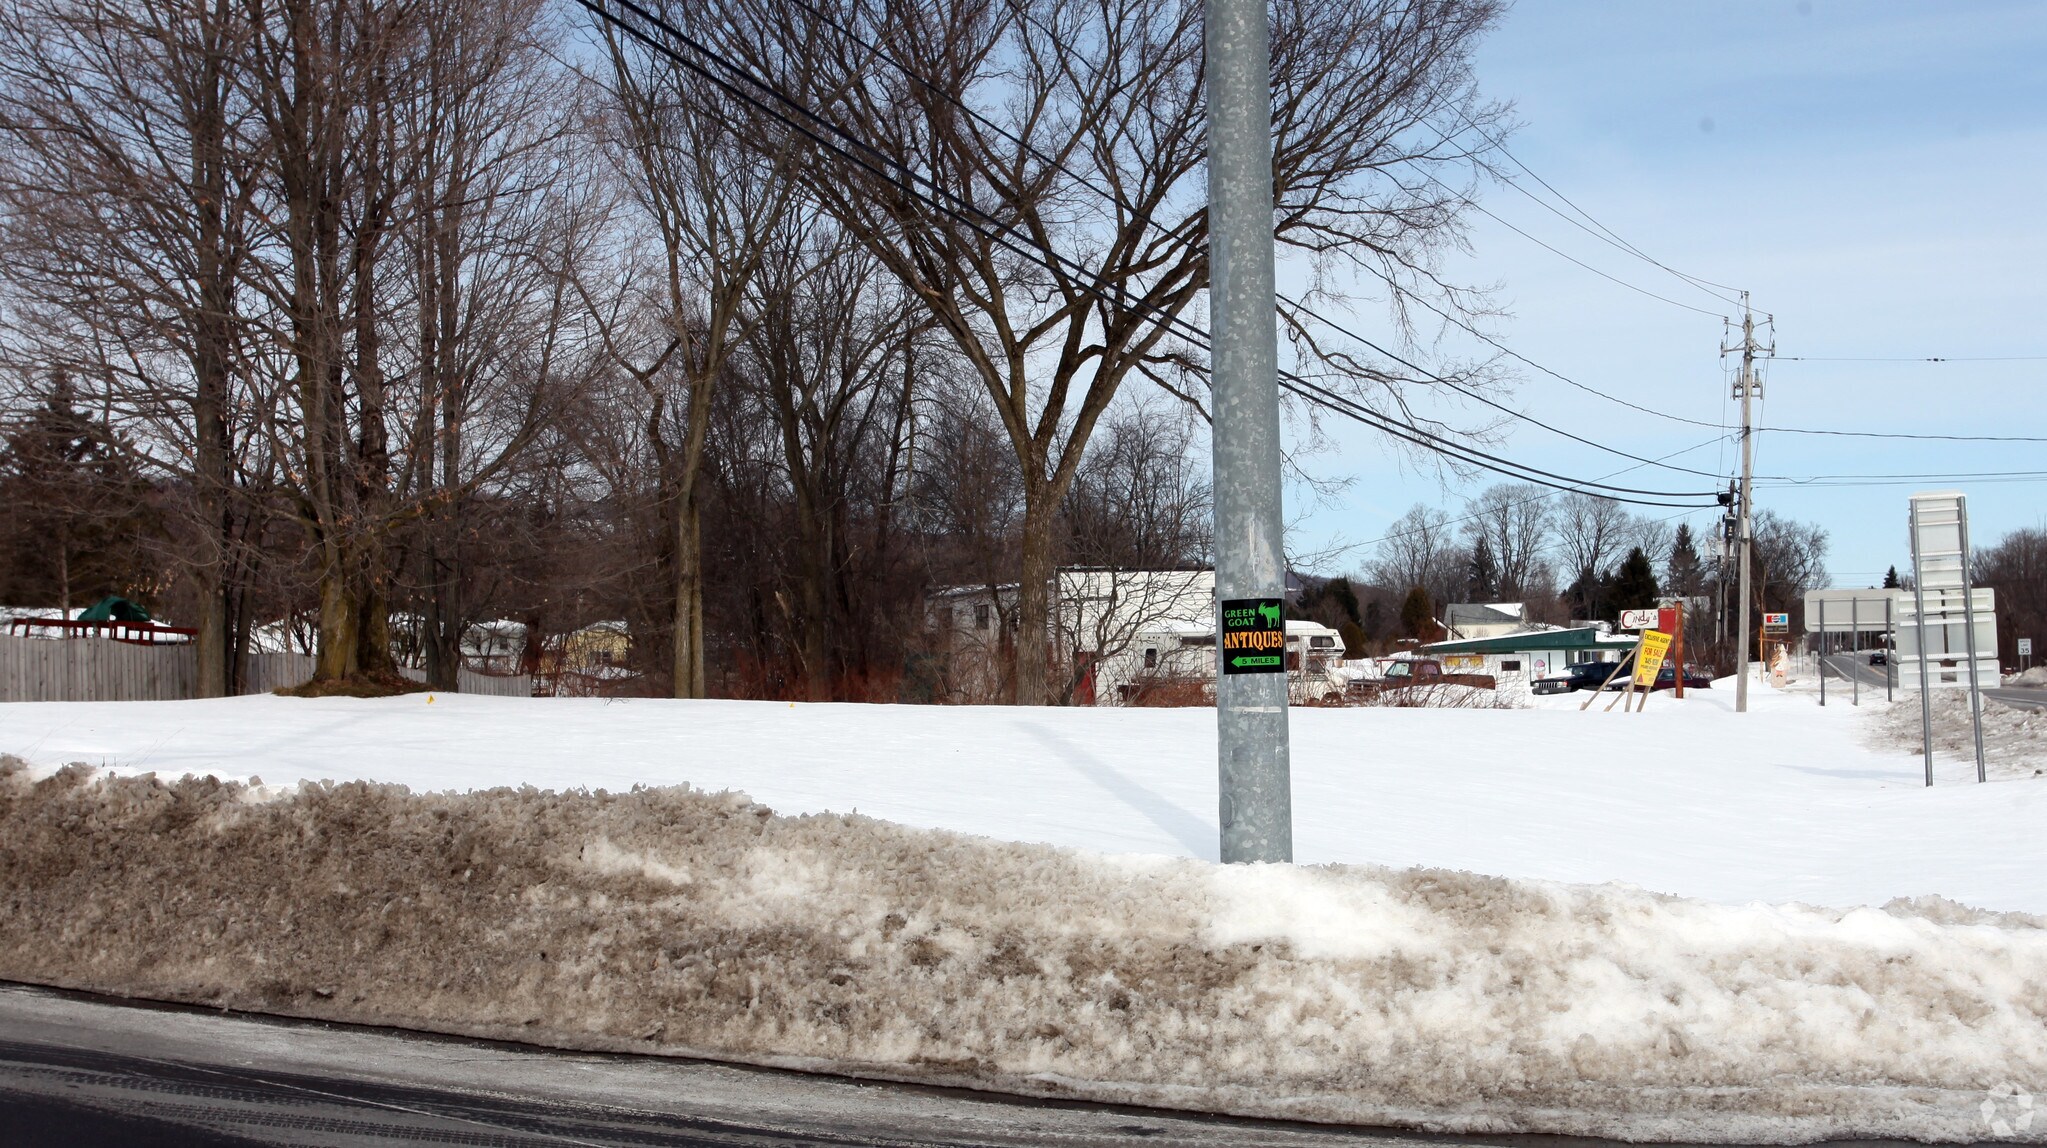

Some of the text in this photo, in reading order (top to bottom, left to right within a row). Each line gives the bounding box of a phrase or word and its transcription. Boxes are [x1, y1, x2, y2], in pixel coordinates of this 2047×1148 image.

[1225, 608, 1255, 618] GREEN
[1228, 618, 1255, 627] GOAT
[1224, 631, 1283, 651] ANTIQUES
[1644, 647, 1663, 657] FOR SALE
